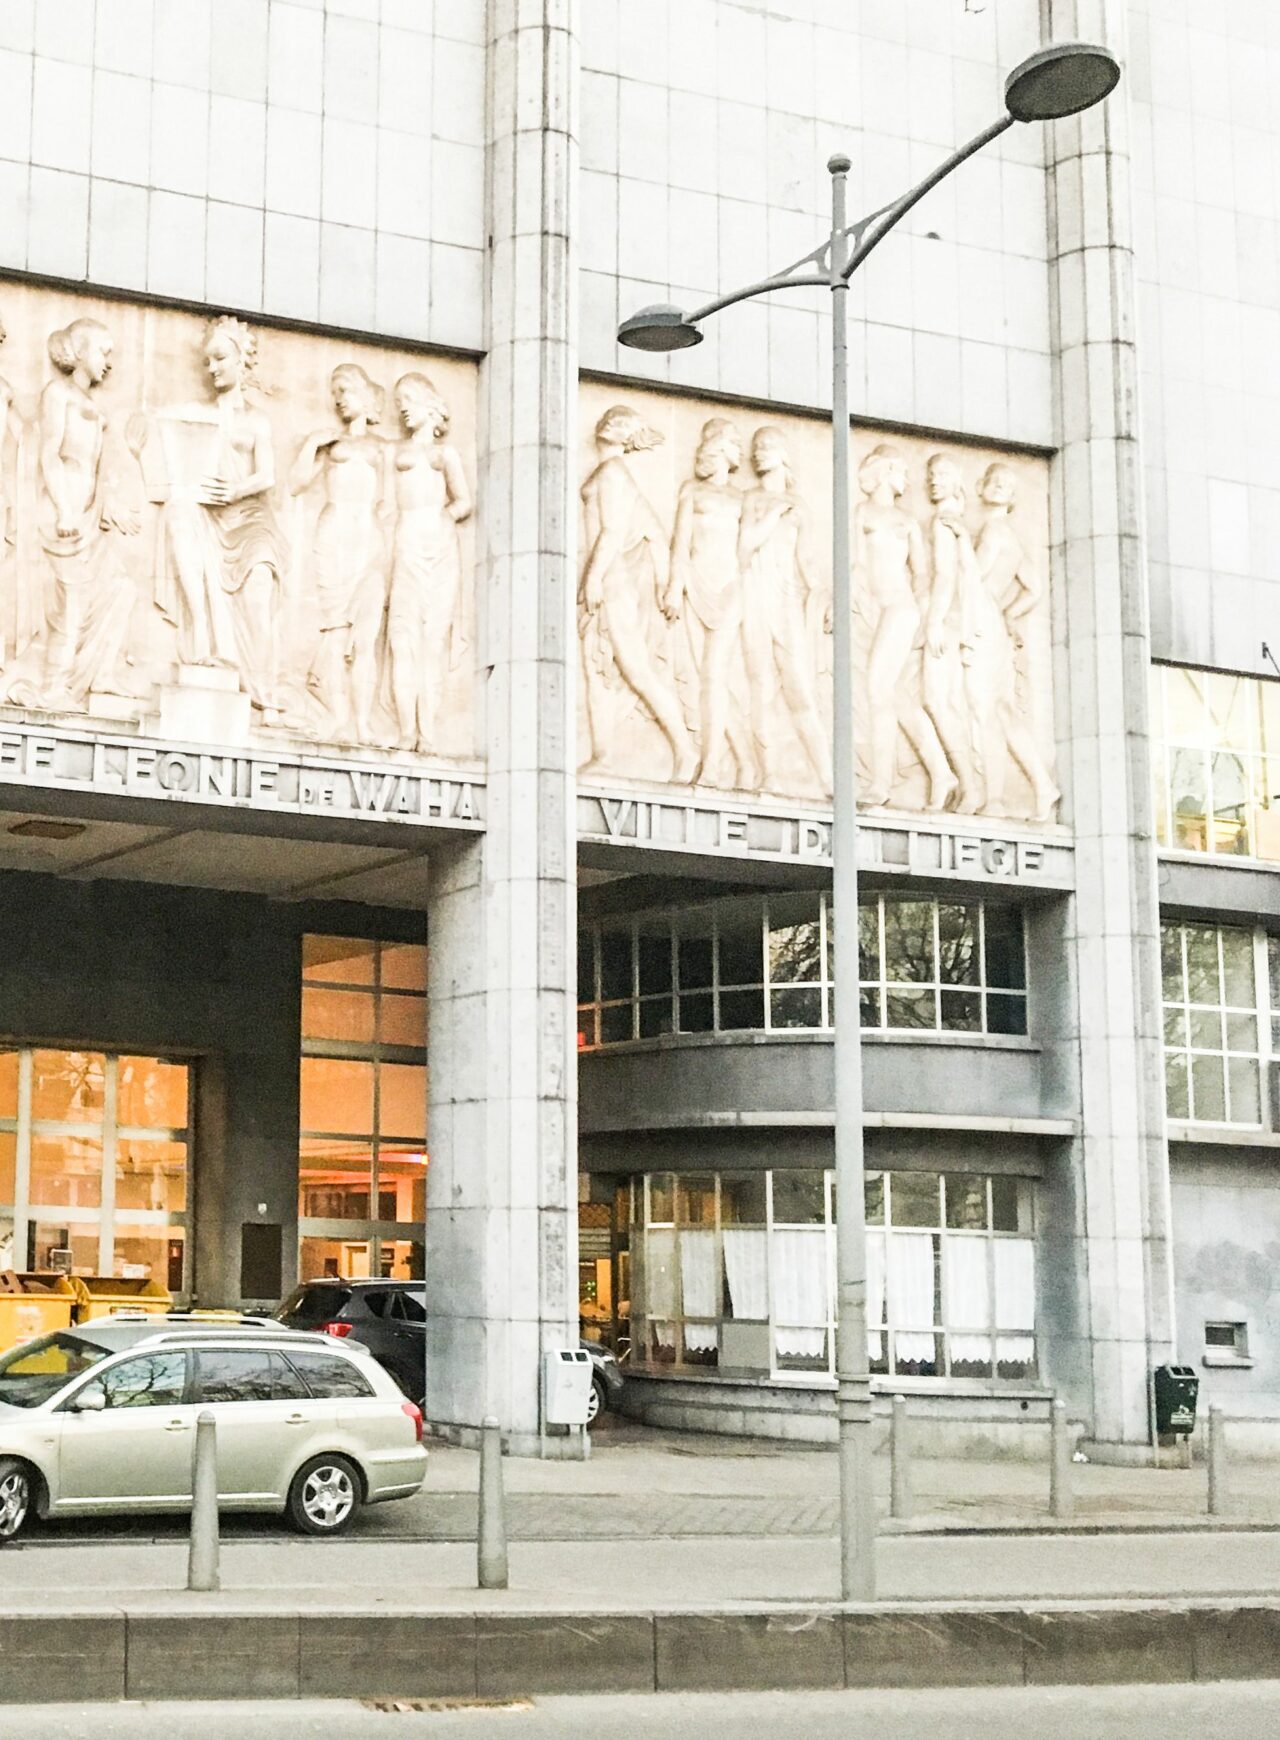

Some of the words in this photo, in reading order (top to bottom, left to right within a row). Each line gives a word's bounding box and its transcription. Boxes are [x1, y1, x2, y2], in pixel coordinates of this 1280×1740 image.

[93, 743, 280, 802] LEONIE
[302, 782, 334, 806] DE
[349, 771, 481, 821] WAHA
[599, 798, 748, 849] VILLE
